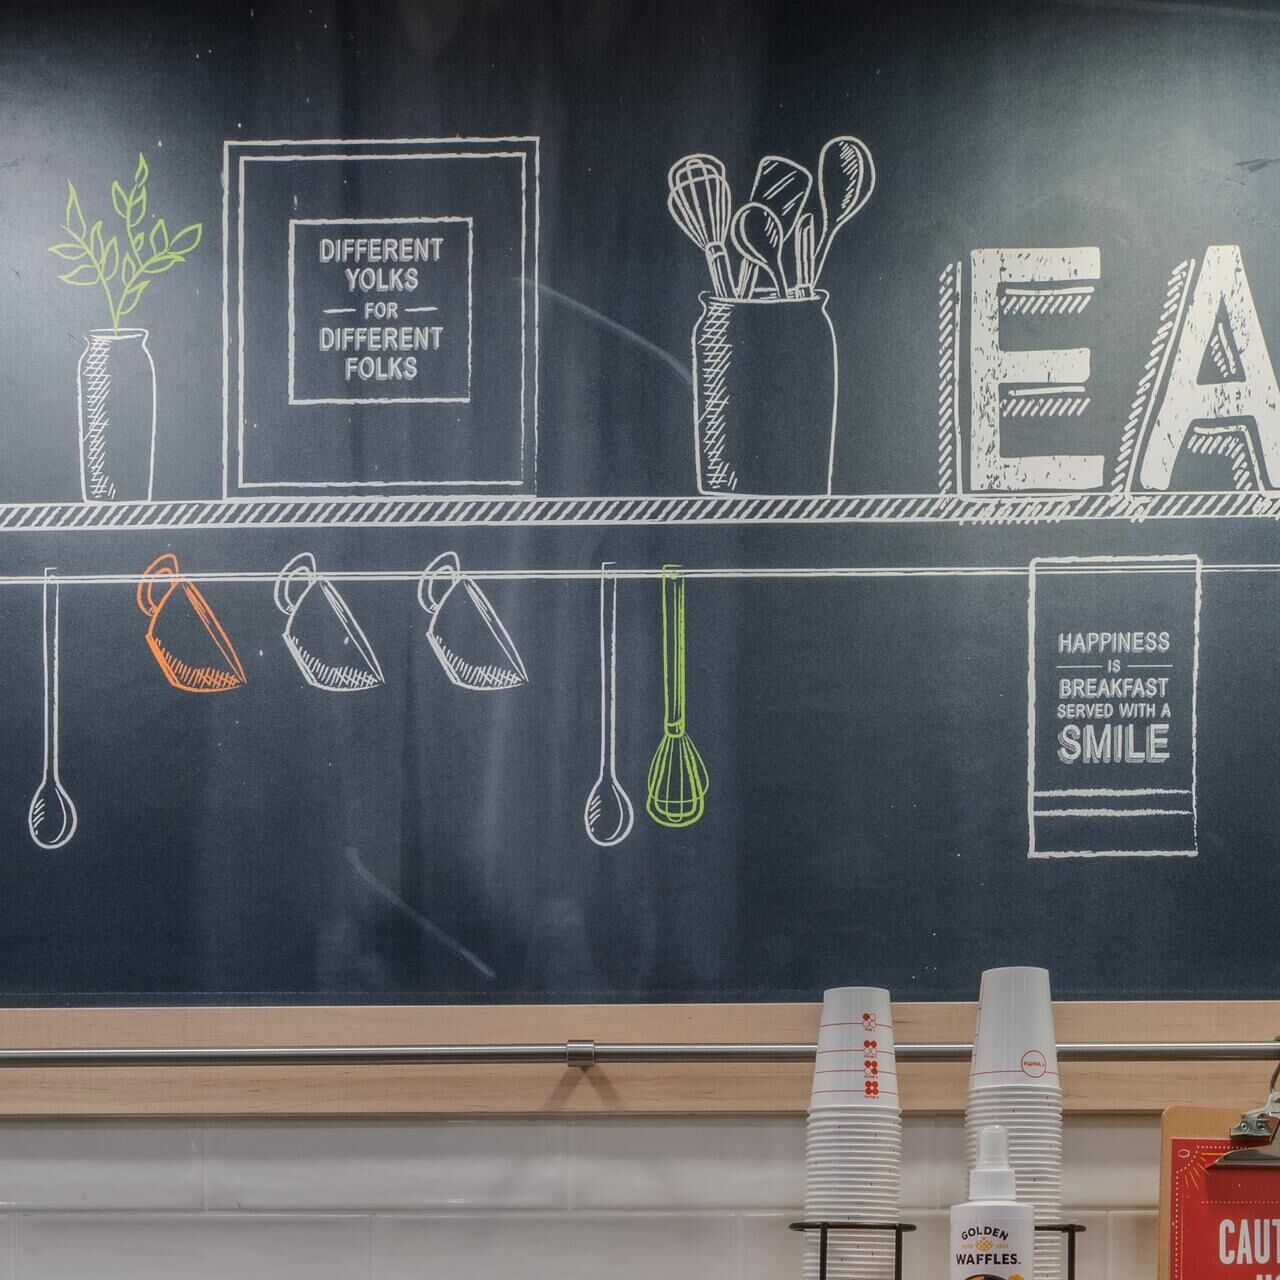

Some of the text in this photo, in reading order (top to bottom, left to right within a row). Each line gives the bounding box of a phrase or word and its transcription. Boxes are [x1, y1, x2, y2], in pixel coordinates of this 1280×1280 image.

[320, 237, 444, 262] DIFFERENT
[344, 267, 419, 292] YOLKS
[364, 302, 399, 320] FOR
[320, 326, 444, 351] DIFFERENT
[344, 356, 418, 380] FOLKS
[1058, 632, 1170, 654] HAPPINESS
[1107, 659, 1121, 673] IS
[1058, 677, 1169, 699] BREAKFAST
[1056, 703, 1171, 719] SERVED WITH A
[1057, 723, 1170, 764] SMILE
[961, 1226, 1009, 1240] GOLDEN
